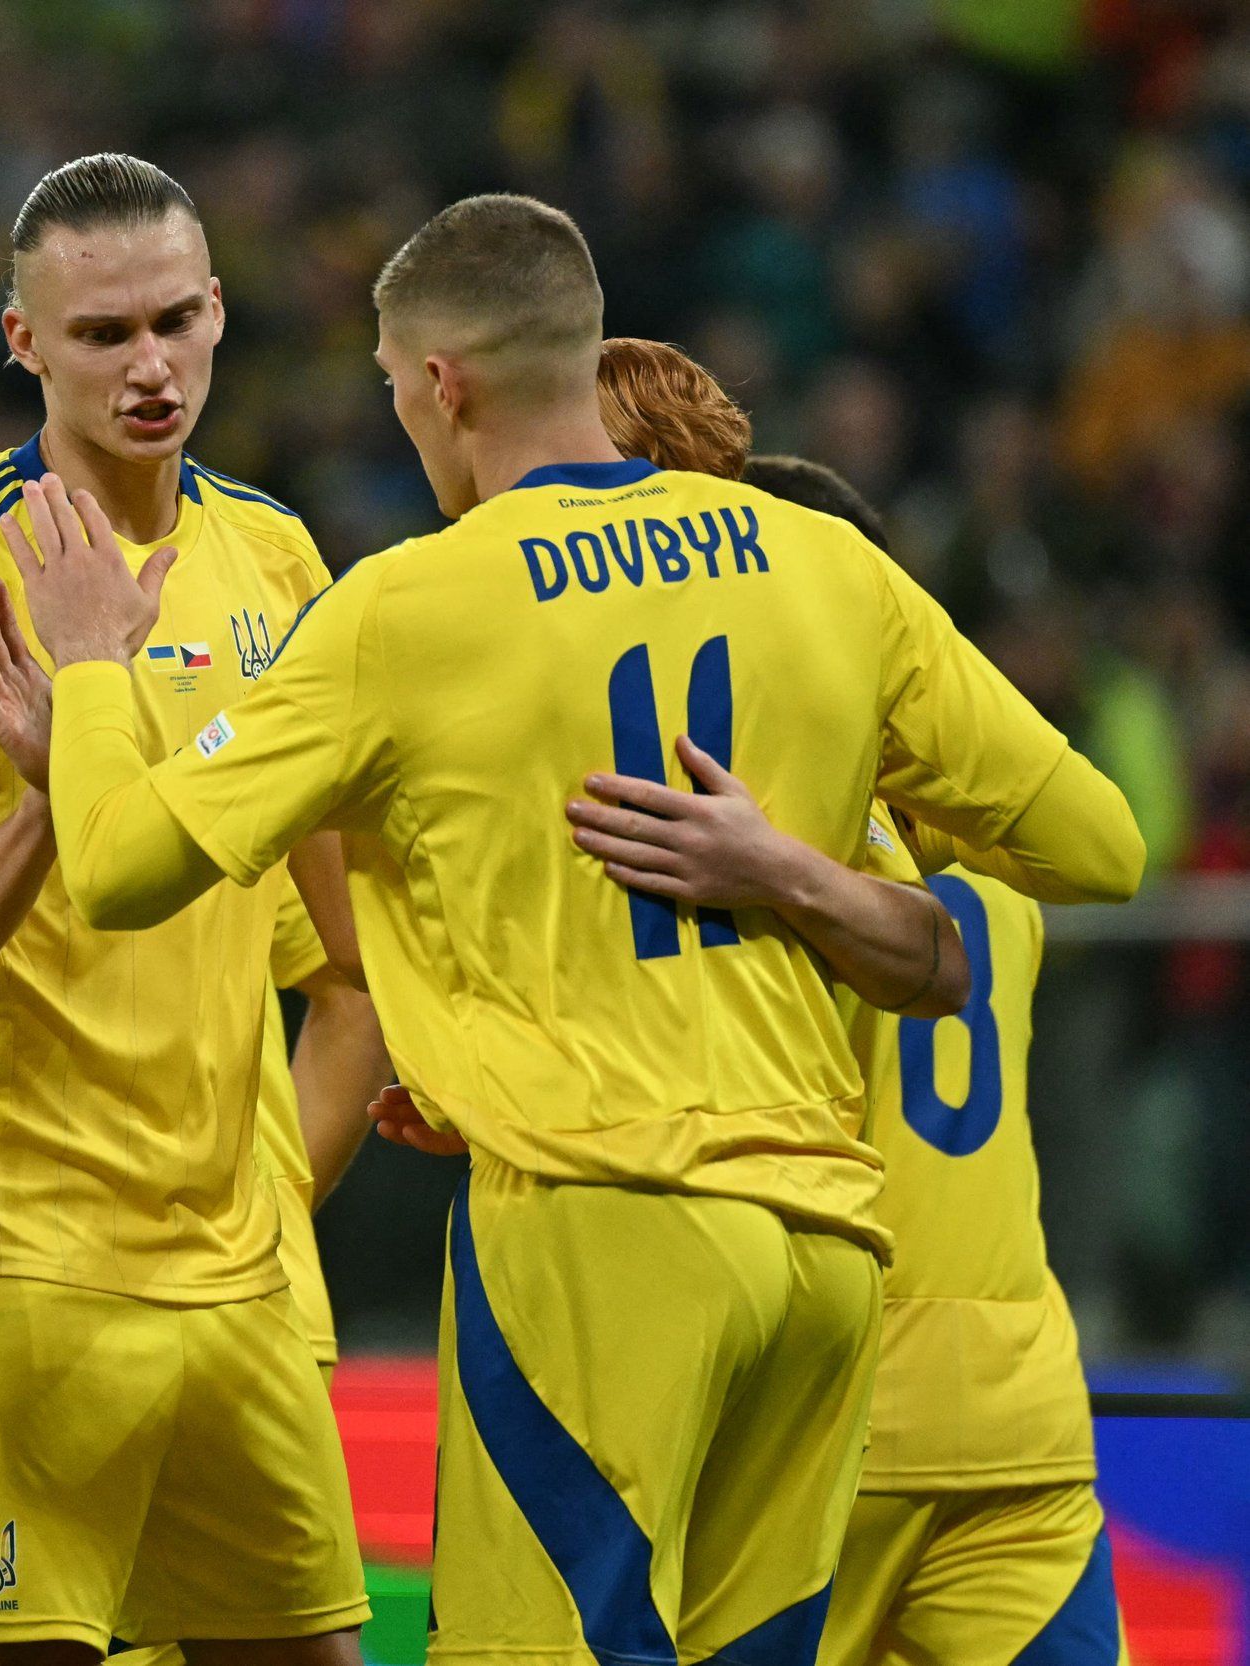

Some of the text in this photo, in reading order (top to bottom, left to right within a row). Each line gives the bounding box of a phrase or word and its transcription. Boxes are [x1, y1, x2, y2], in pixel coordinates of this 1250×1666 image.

[518, 505, 770, 602] DOVBYK
[608, 634, 741, 961] 11
[897, 873, 1003, 1158] 8
